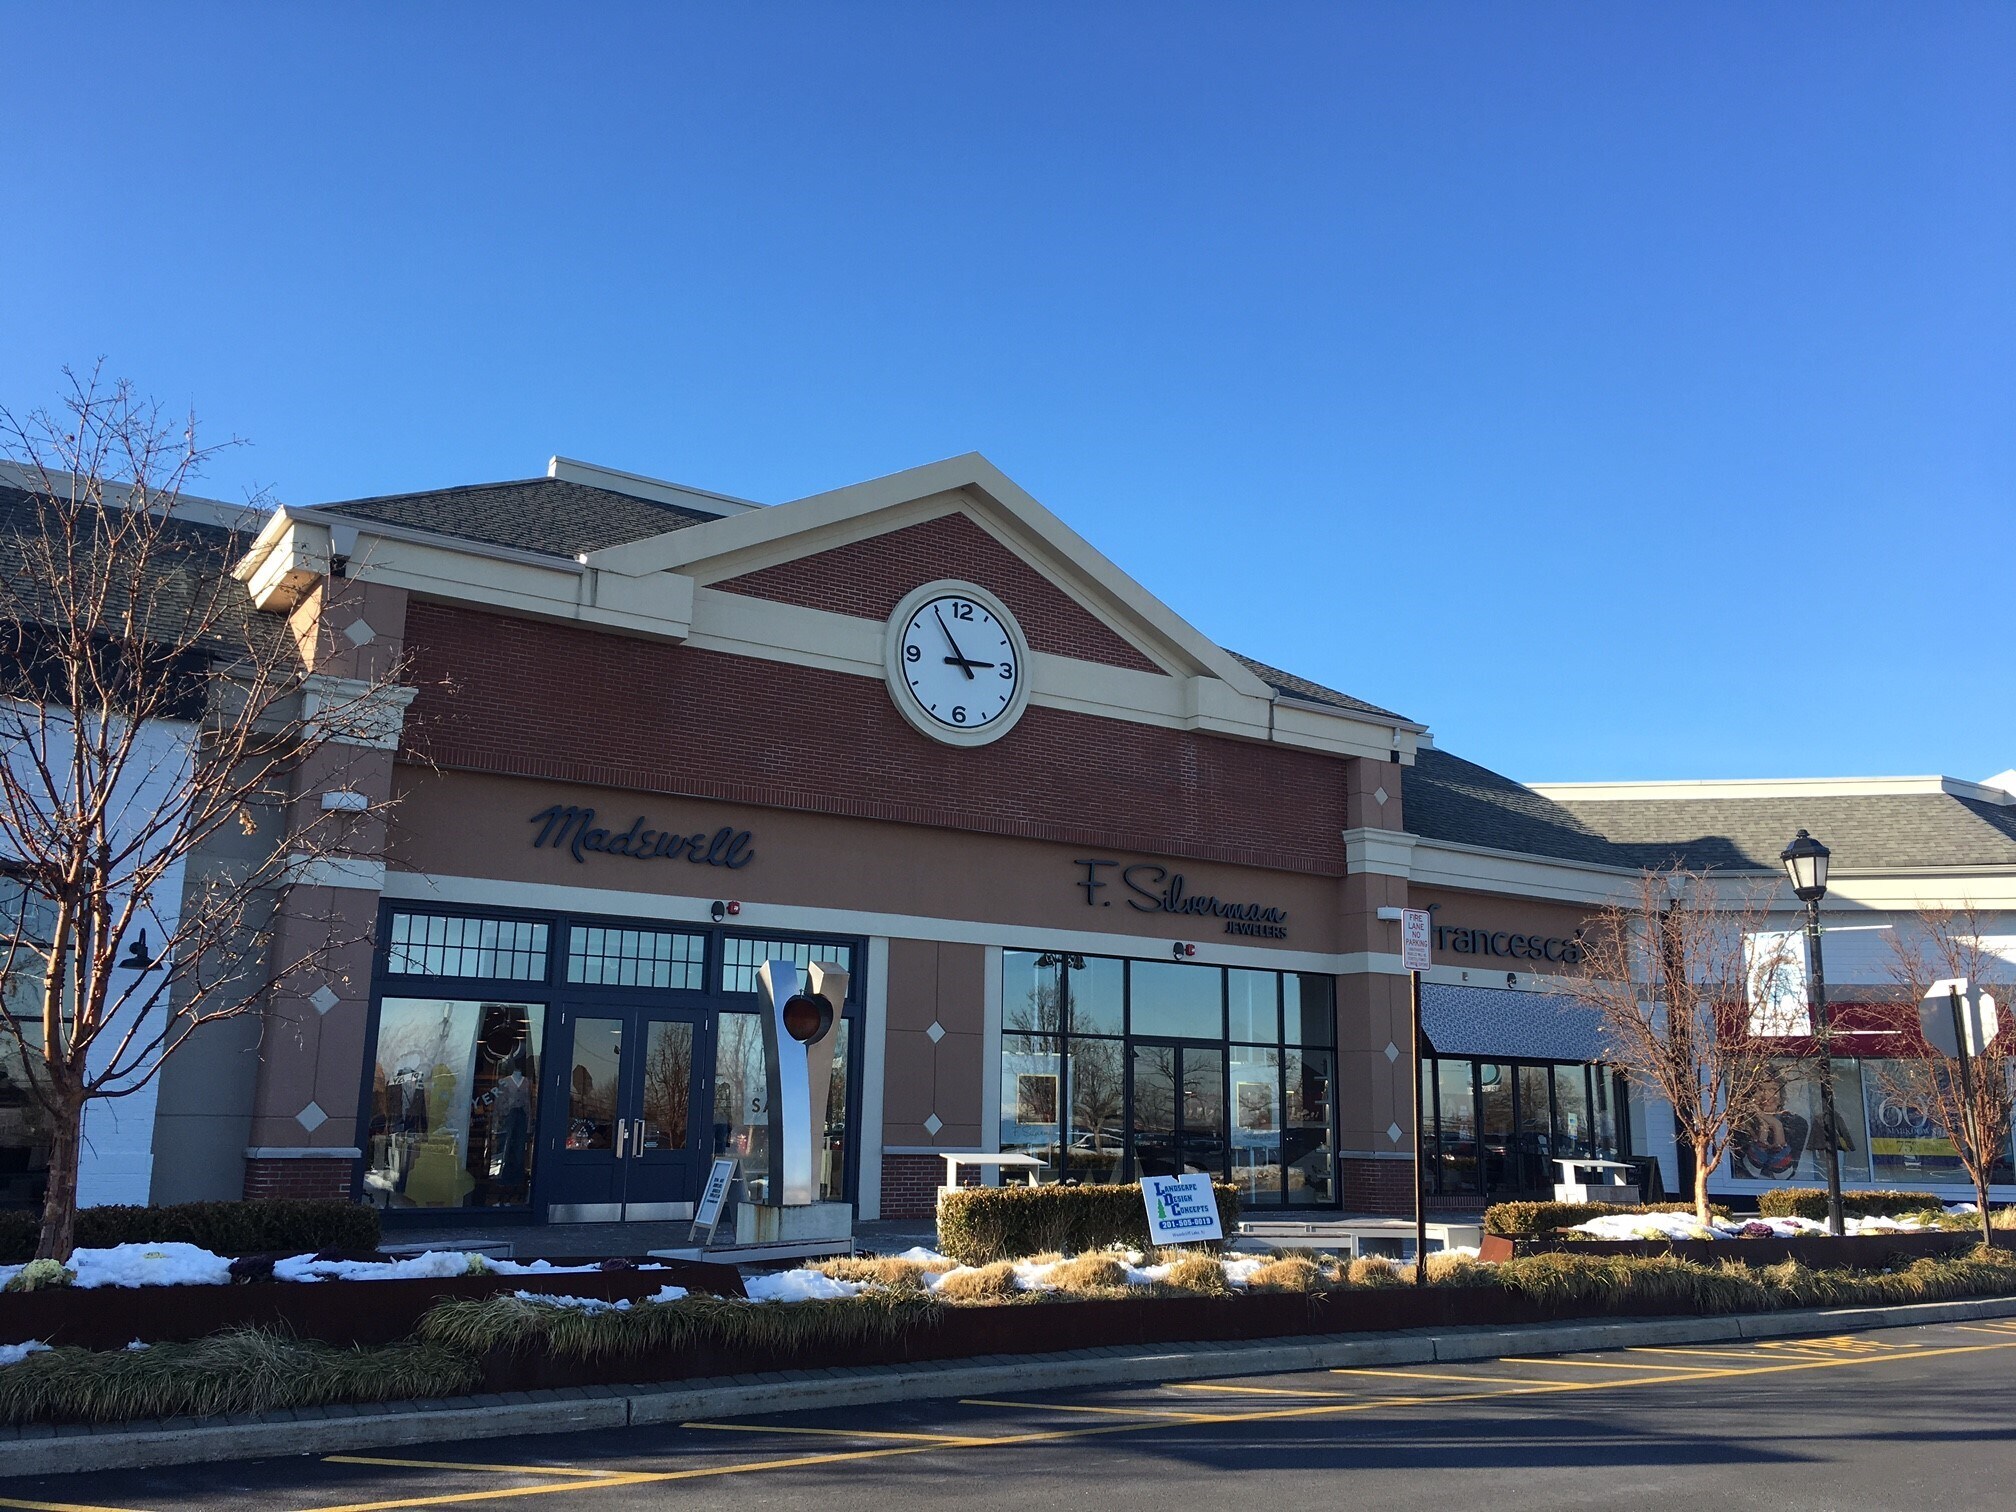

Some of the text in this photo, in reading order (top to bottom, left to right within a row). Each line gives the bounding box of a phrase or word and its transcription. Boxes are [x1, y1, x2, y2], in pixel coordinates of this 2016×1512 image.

[952, 601, 974, 622] 12
[906, 645, 921, 662] 9
[999, 662, 1013, 680] 3
[952, 705, 966, 723] 6
[530, 804, 755, 869] Madewell
[1074, 859, 1288, 924] F. Silverman
[1409, 913, 1423, 922] FIRE
[1225, 921, 1288, 939] JEWELERS
[1408, 922, 1425, 931] LANE
[1411, 930, 1421, 939] NO
[1406, 938, 1428, 947] PARKING
[1154, 1182, 1198, 1196] LANDSCAPE
[1163, 1193, 1193, 1206] DESIGN
[1171, 1203, 1209, 1216] CONCEPTS
